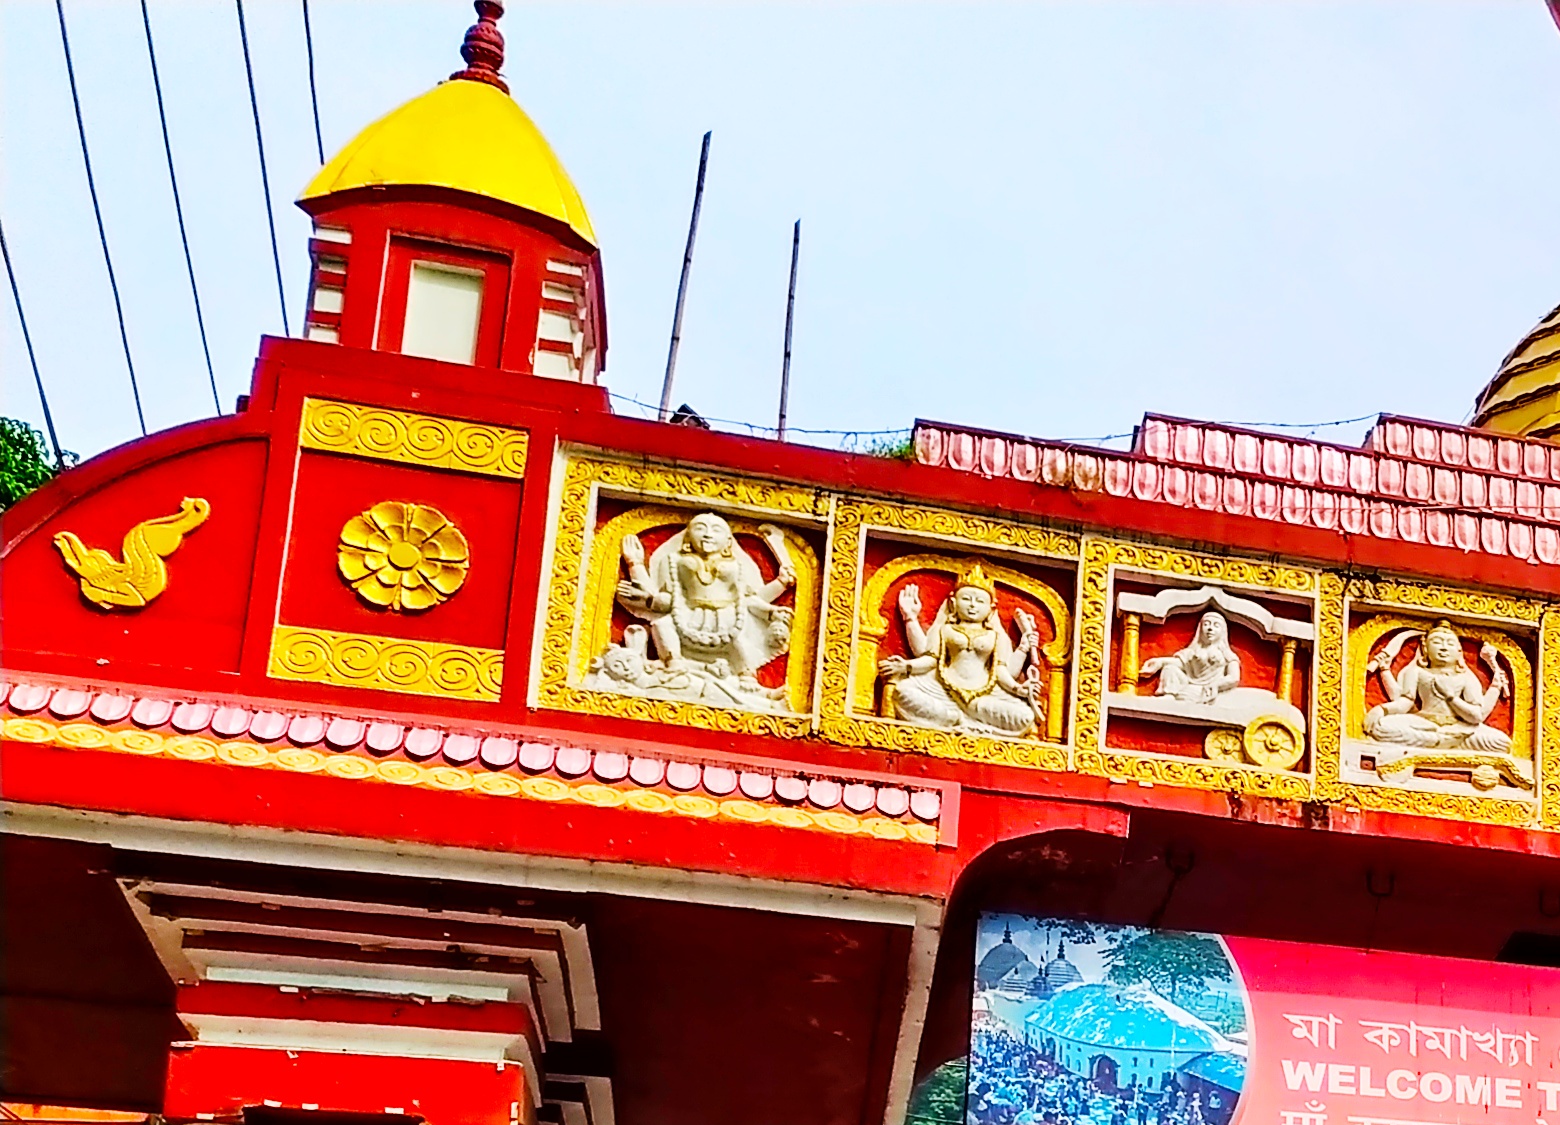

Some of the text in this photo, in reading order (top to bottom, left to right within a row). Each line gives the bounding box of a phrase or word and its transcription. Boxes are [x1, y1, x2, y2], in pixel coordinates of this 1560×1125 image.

[1282, 1013, 1343, 1049] মা
[1358, 1020, 1540, 1067] কামাখ্যা
[1281, 1059, 1522, 1108] WELCOME
